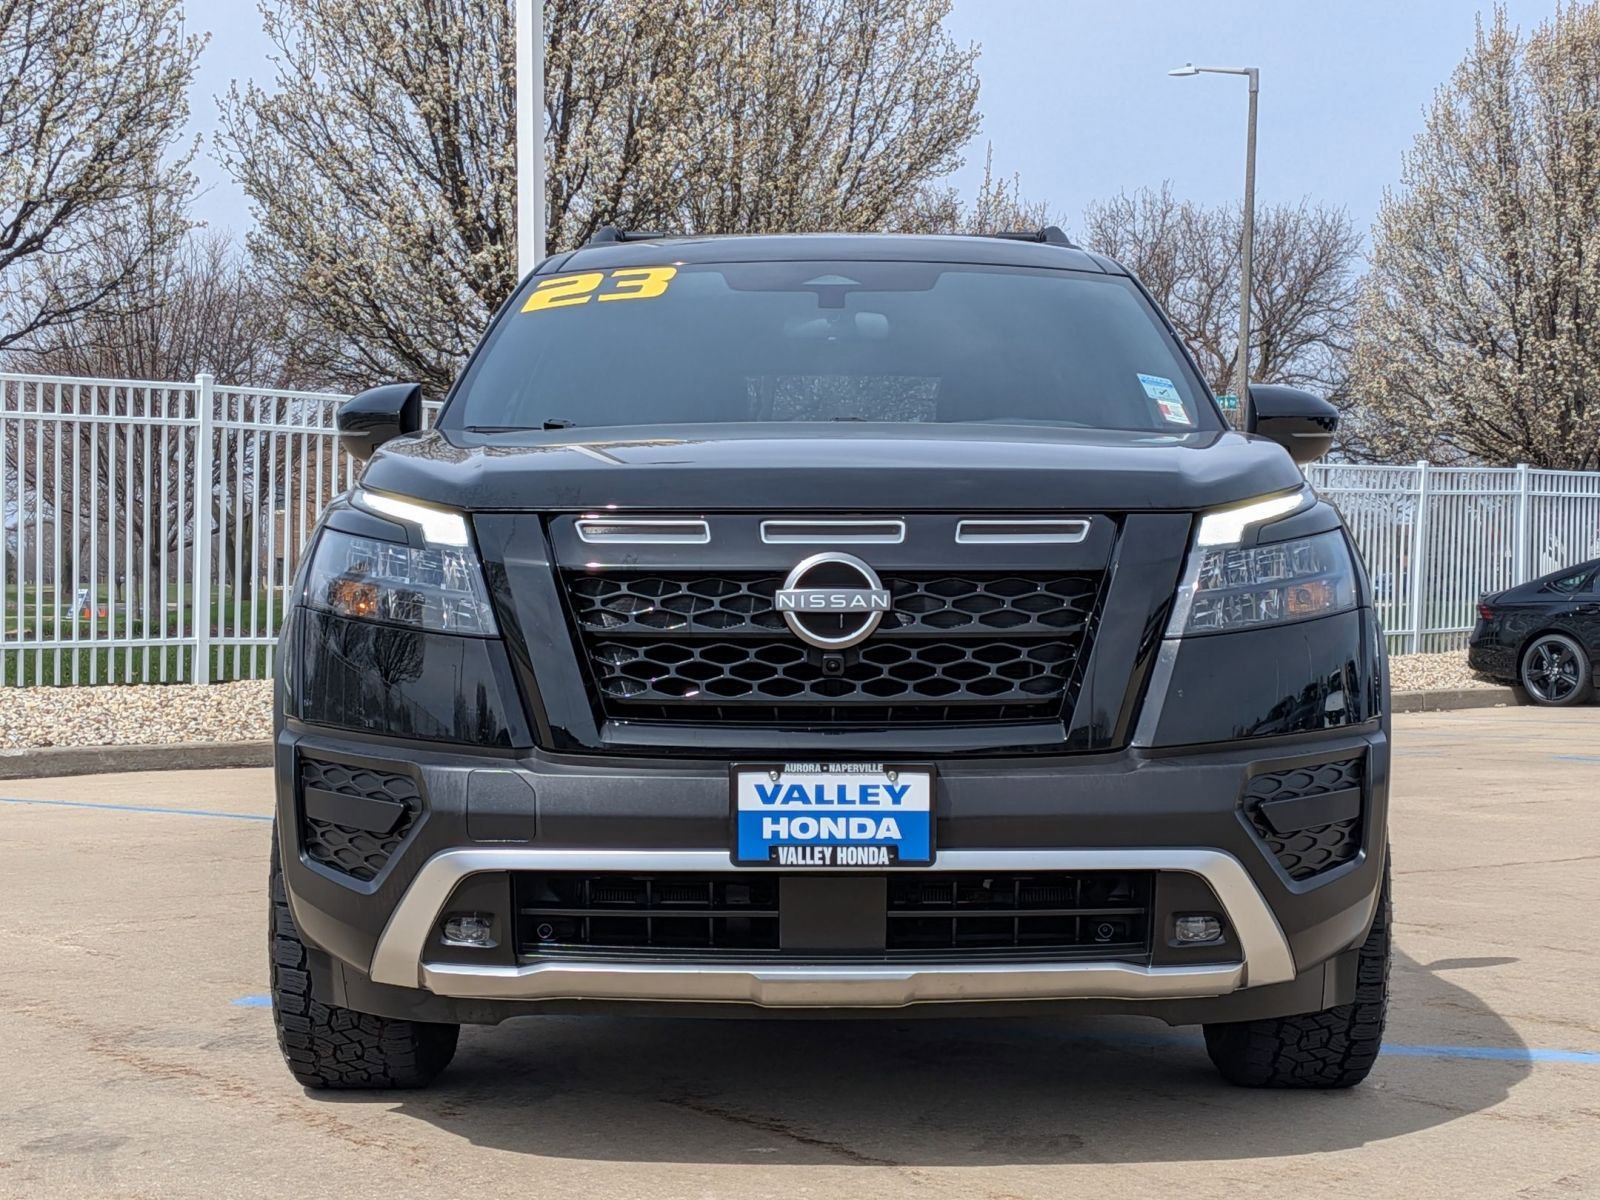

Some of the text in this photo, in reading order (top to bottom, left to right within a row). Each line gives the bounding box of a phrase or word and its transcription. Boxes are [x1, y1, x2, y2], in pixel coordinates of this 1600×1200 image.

[520, 266, 678, 313] 23
[779, 594, 888, 608] NISSAN
[784, 763, 884, 773] AURORA NAPERVILLE
[754, 784, 911, 805] VALLEY
[762, 817, 902, 839] HONDA
[777, 846, 889, 865] VALLEY HONDA
